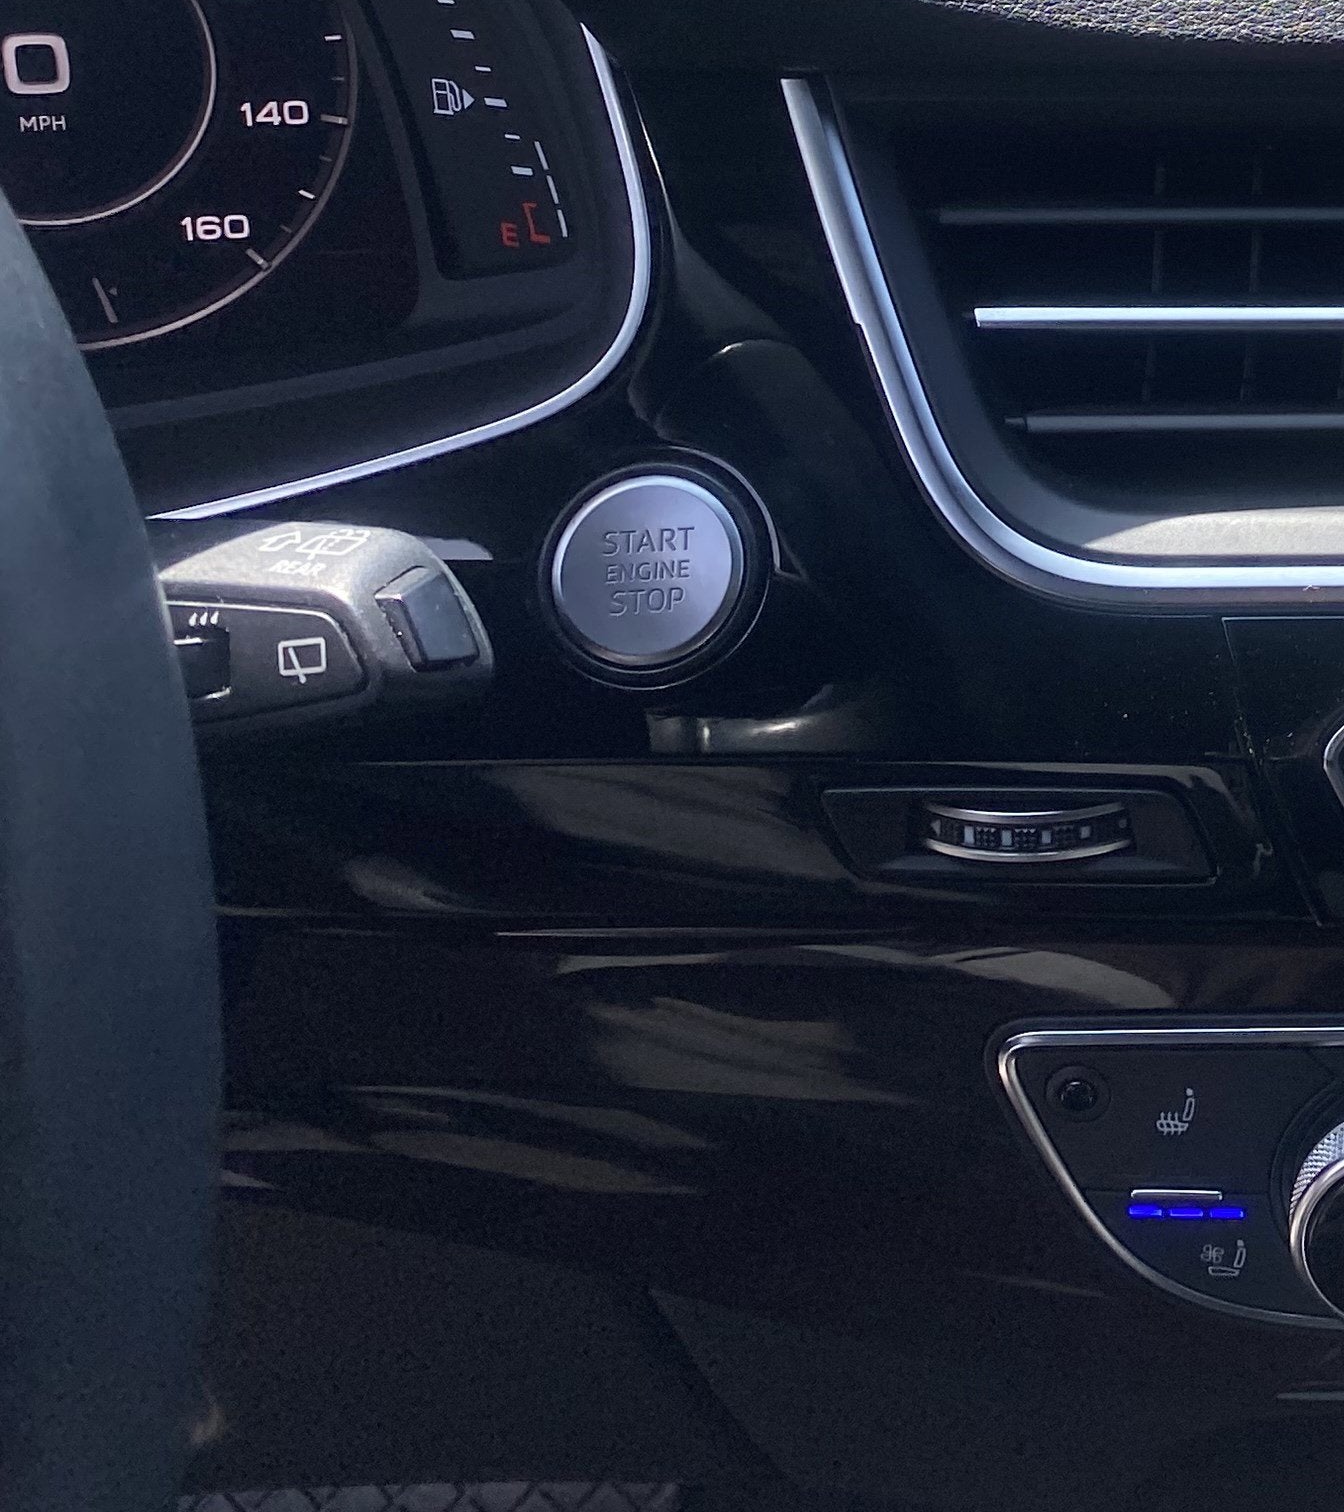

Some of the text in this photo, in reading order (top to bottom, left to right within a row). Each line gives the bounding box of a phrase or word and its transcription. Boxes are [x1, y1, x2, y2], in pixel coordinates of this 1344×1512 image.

[2, 33, 71, 95] 0
[20, 115, 66, 131] MPH
[240, 100, 310, 126] 140
[181, 214, 250, 241] 160
[500, 222, 519, 247] E
[602, 526, 695, 556] START
[269, 559, 327, 576] REAR
[606, 559, 691, 584] ENGINE
[609, 587, 686, 617] STOP
